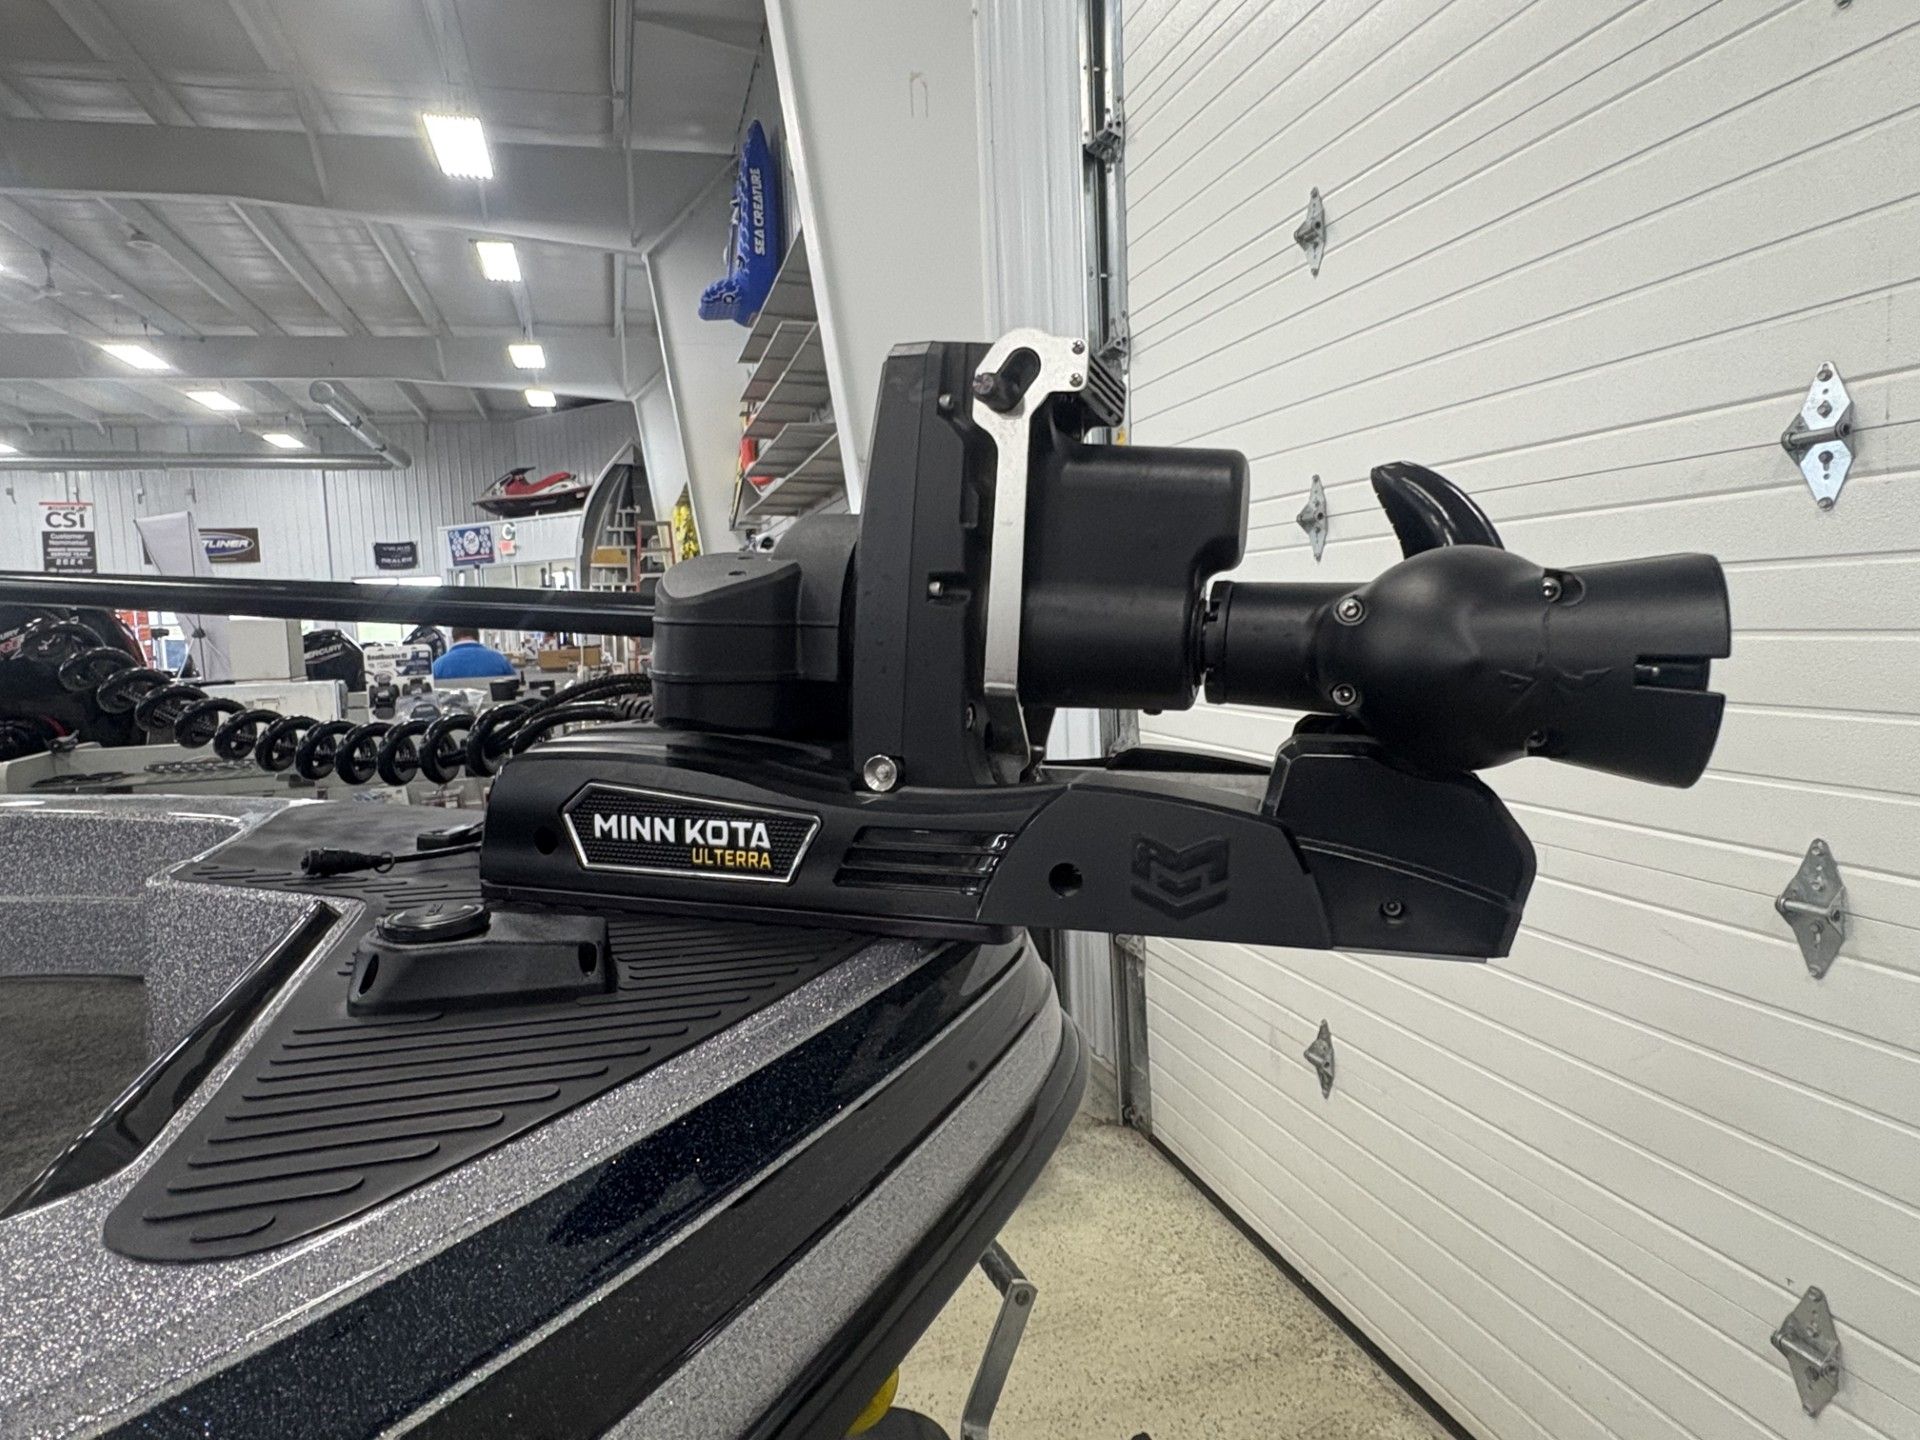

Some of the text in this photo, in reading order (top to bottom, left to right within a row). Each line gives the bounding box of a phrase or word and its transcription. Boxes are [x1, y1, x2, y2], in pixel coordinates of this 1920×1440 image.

[750, 168, 765, 255] SEA CREATURE
[594, 813, 771, 849] MINN KOTA
[692, 847, 772, 869] ULTERRA
